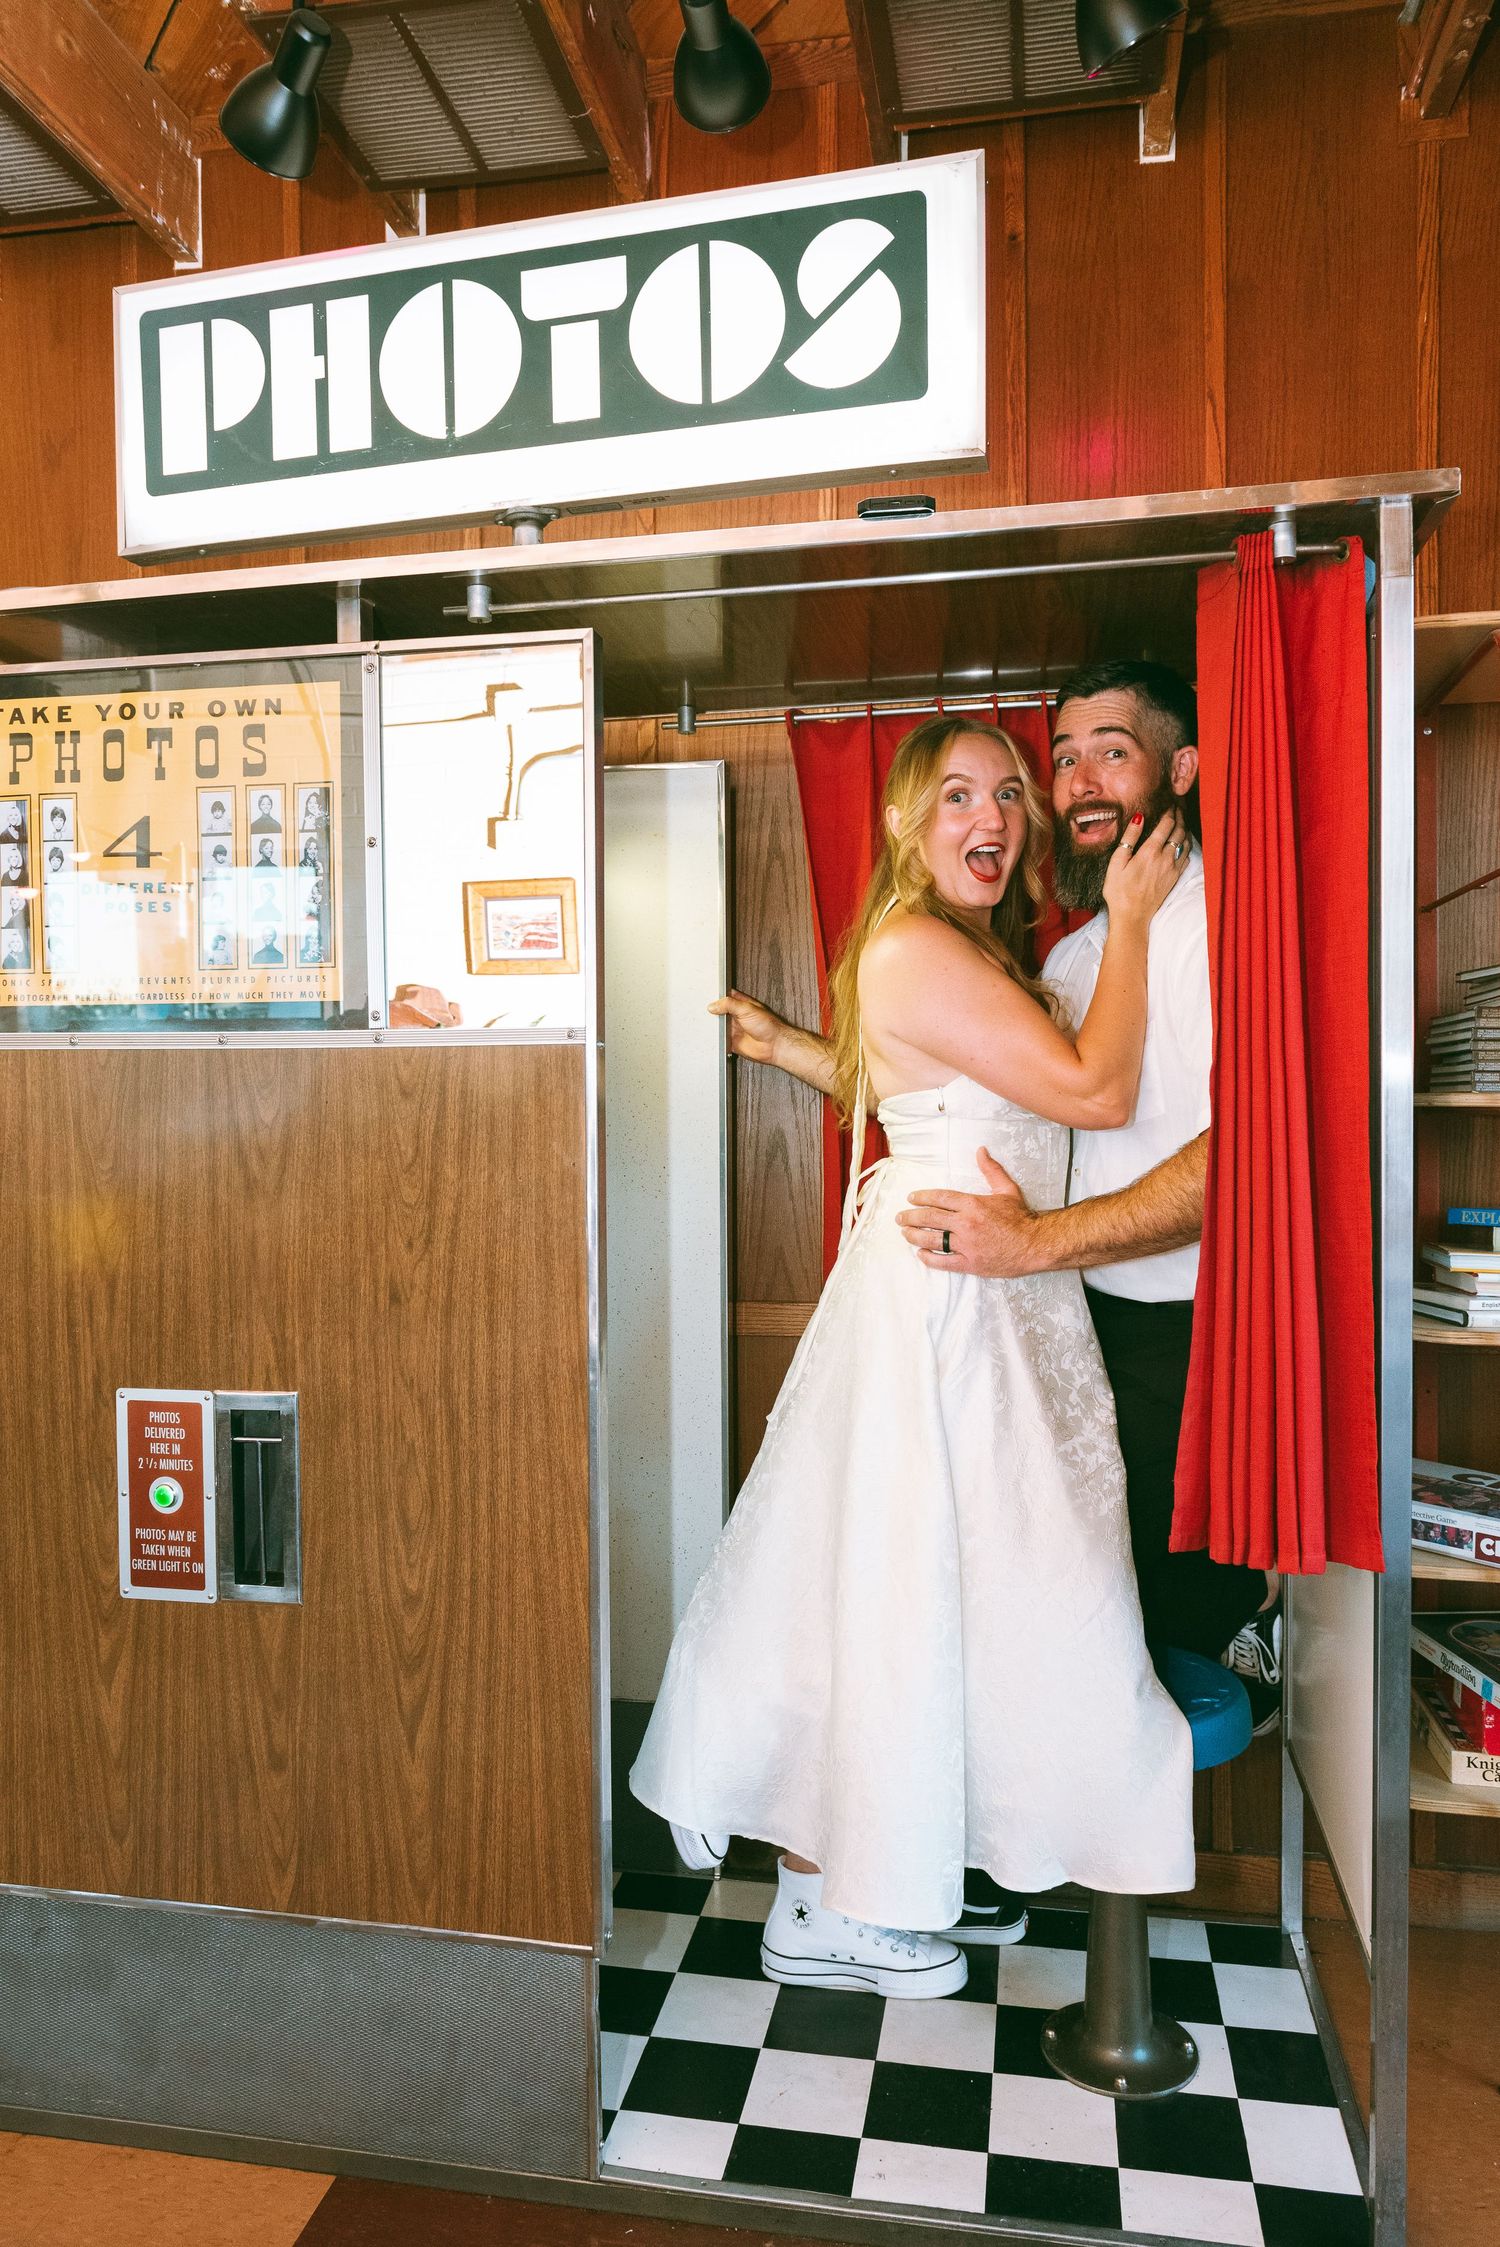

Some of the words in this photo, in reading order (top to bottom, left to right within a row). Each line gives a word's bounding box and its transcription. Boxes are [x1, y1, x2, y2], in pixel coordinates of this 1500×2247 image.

[157, 217, 902, 477] PHOTOS
[0, 706, 72, 725] AKE
[95, 701, 185, 722] YOUR
[207, 698, 282, 718] OWN
[9, 723, 267, 785] PHOTOS
[102, 815, 163, 869] 4
[131, 976, 192, 986] REVENTS
[201, 976, 257, 985] BLURRED
[266, 974, 328, 984] PICTURES
[7, 993, 69, 1002] PHOTOGRAPH
[75, 991, 121, 1002] PERFETLY
[127, 990, 186, 1001] GARDLESS
[191, 992, 203, 1000] OF
[209, 992, 231, 1000] HOW
[237, 991, 264, 1000] MUCH
[270, 991, 294, 1000] THEY
[299, 990, 328, 999] MOVE
[1461, 1210, 1500, 1224] EXPL
[149, 1411, 181, 1424] PHOTOS
[144, 1426, 186, 1440] DELIVERED
[150, 1442, 170, 1455] HERE
[171, 1443, 181, 1455] IN
[138, 1457, 144, 1469] 2
[159, 1458, 194, 1471] MINUTES
[135, 1527, 166, 1541] PHOTOS
[168, 1529, 185, 1542] MAY
[186, 1530, 197, 1543] BE
[141, 1543, 166, 1556] TAKEN
[167, 1545, 191, 1558] WHEN
[131, 1558, 157, 1571] GREEN
[159, 1560, 181, 1573] LIGHT
[182, 1561, 190, 1574] IS
[192, 1562, 204, 1574] ON
